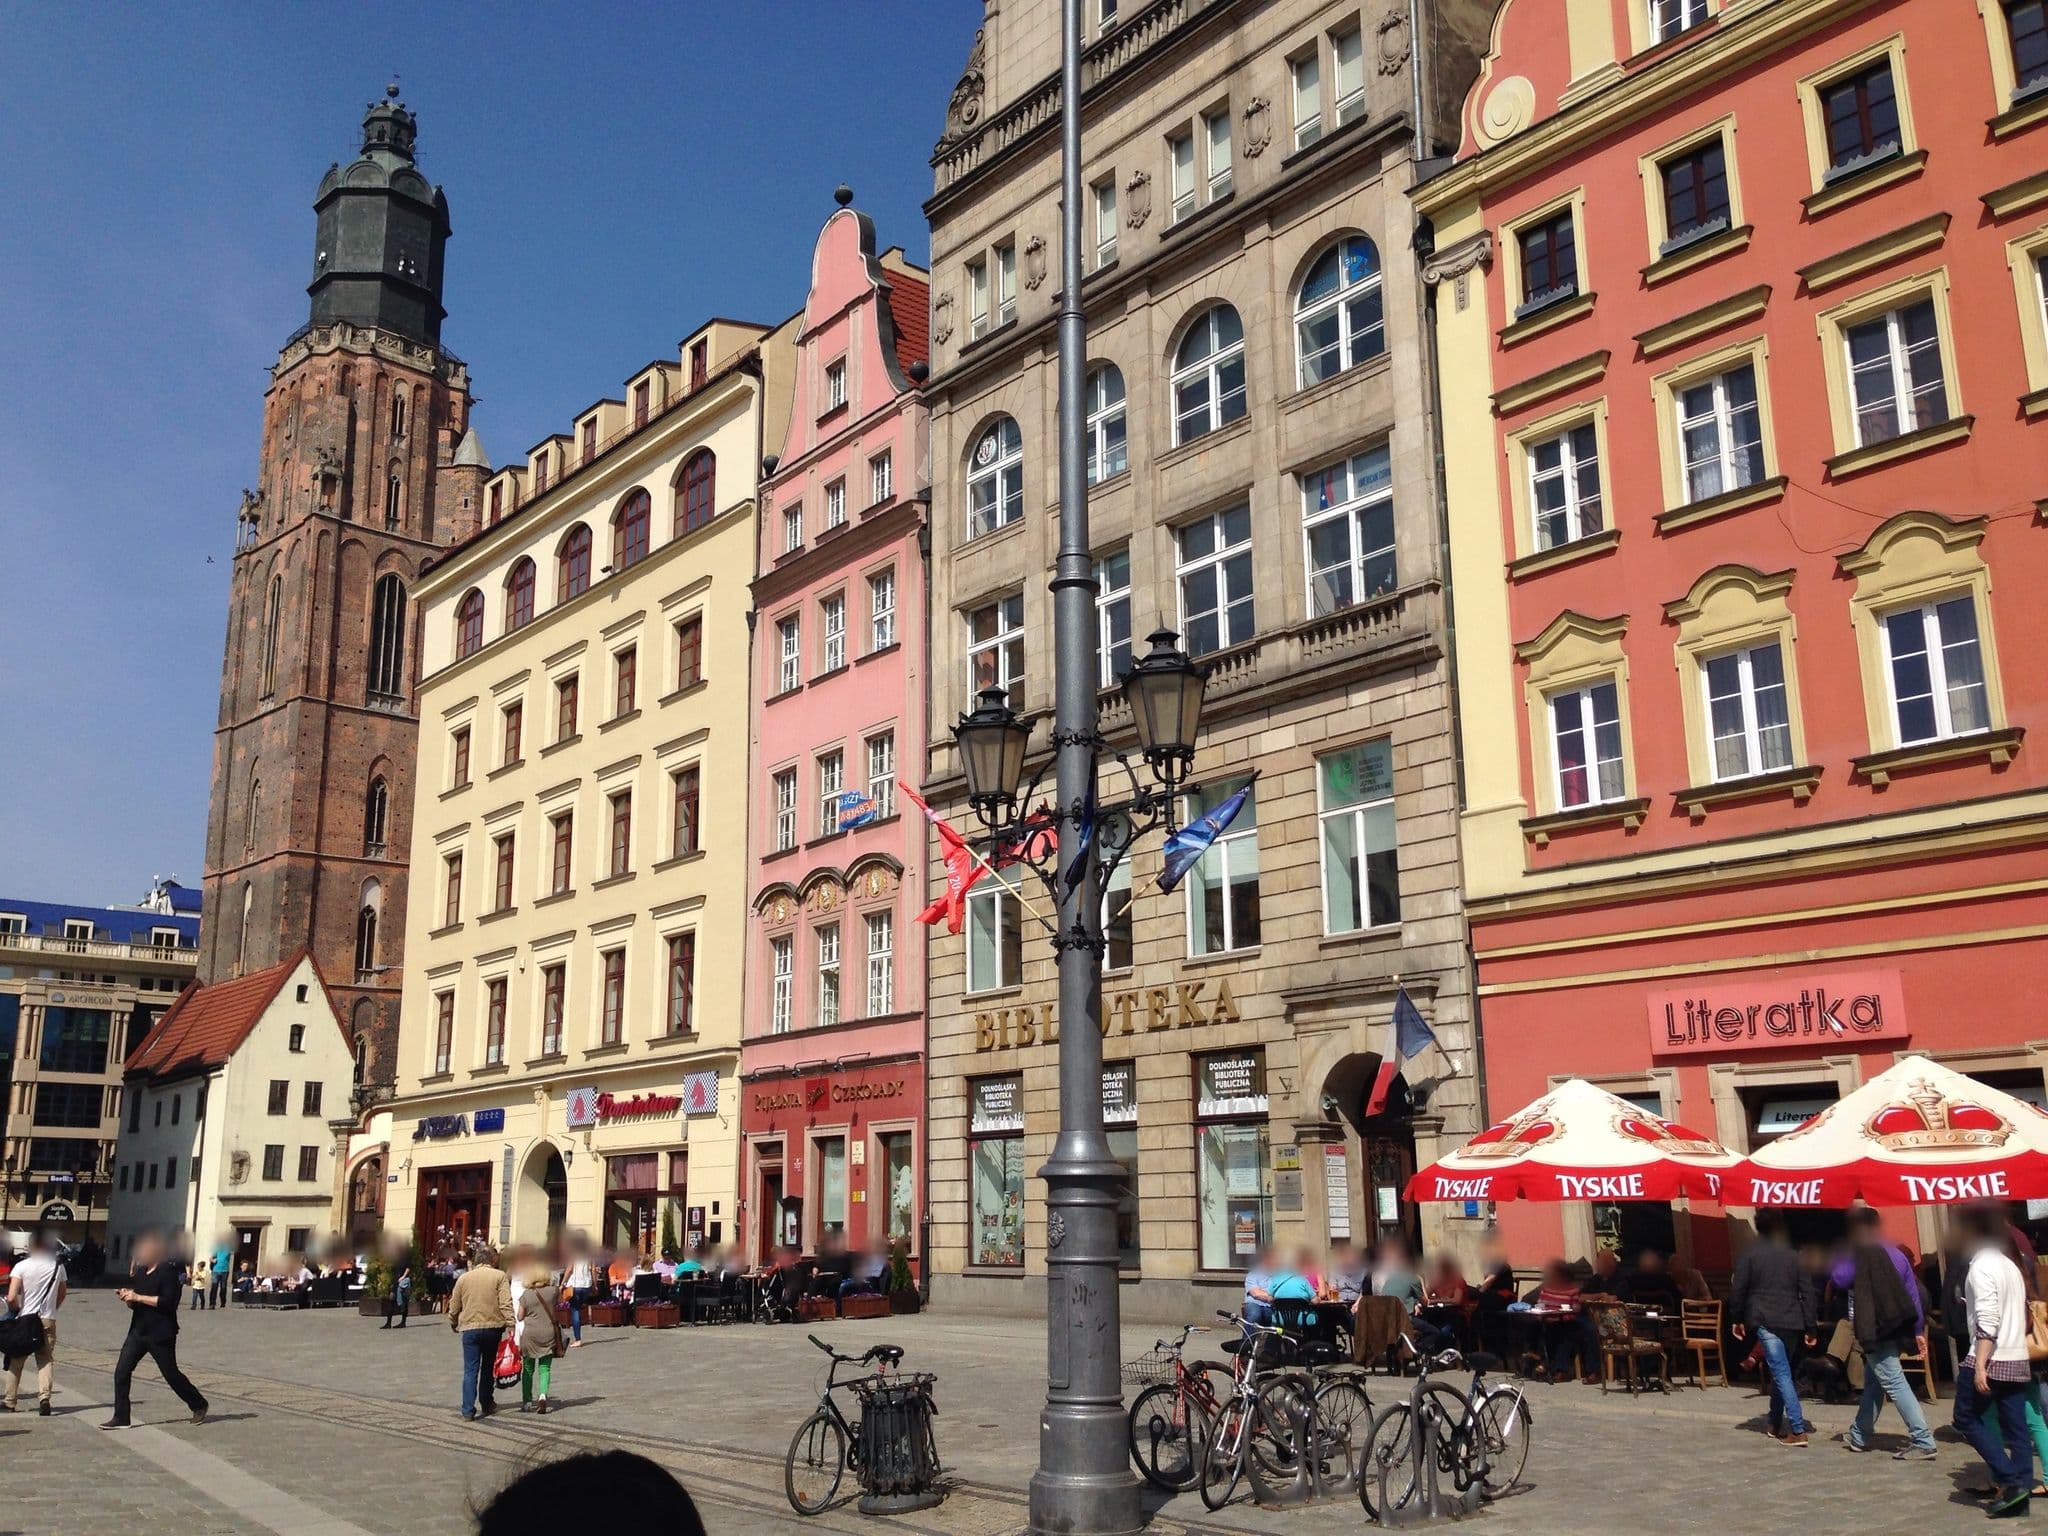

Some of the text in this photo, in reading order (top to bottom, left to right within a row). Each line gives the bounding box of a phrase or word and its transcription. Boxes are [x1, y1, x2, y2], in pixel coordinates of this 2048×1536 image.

[975, 977, 1240, 1051] BIBLTEKA
[1664, 988, 1882, 1044] Literatka
[1102, 1072, 1128, 1082] OŚLĄSKA
[1102, 1081, 1124, 1090] IOTEKA
[1214, 1069, 1250, 1080] BIBLIOTEKA
[1215, 1078, 1250, 1089] PUBLICZNA
[1434, 1176, 1493, 1199] TYSKIE
[1555, 1173, 1644, 1198] TYSKIE
[1750, 1178, 1824, 1205] TYSKIE
[1900, 1171, 2010, 1202] TYSKIE
